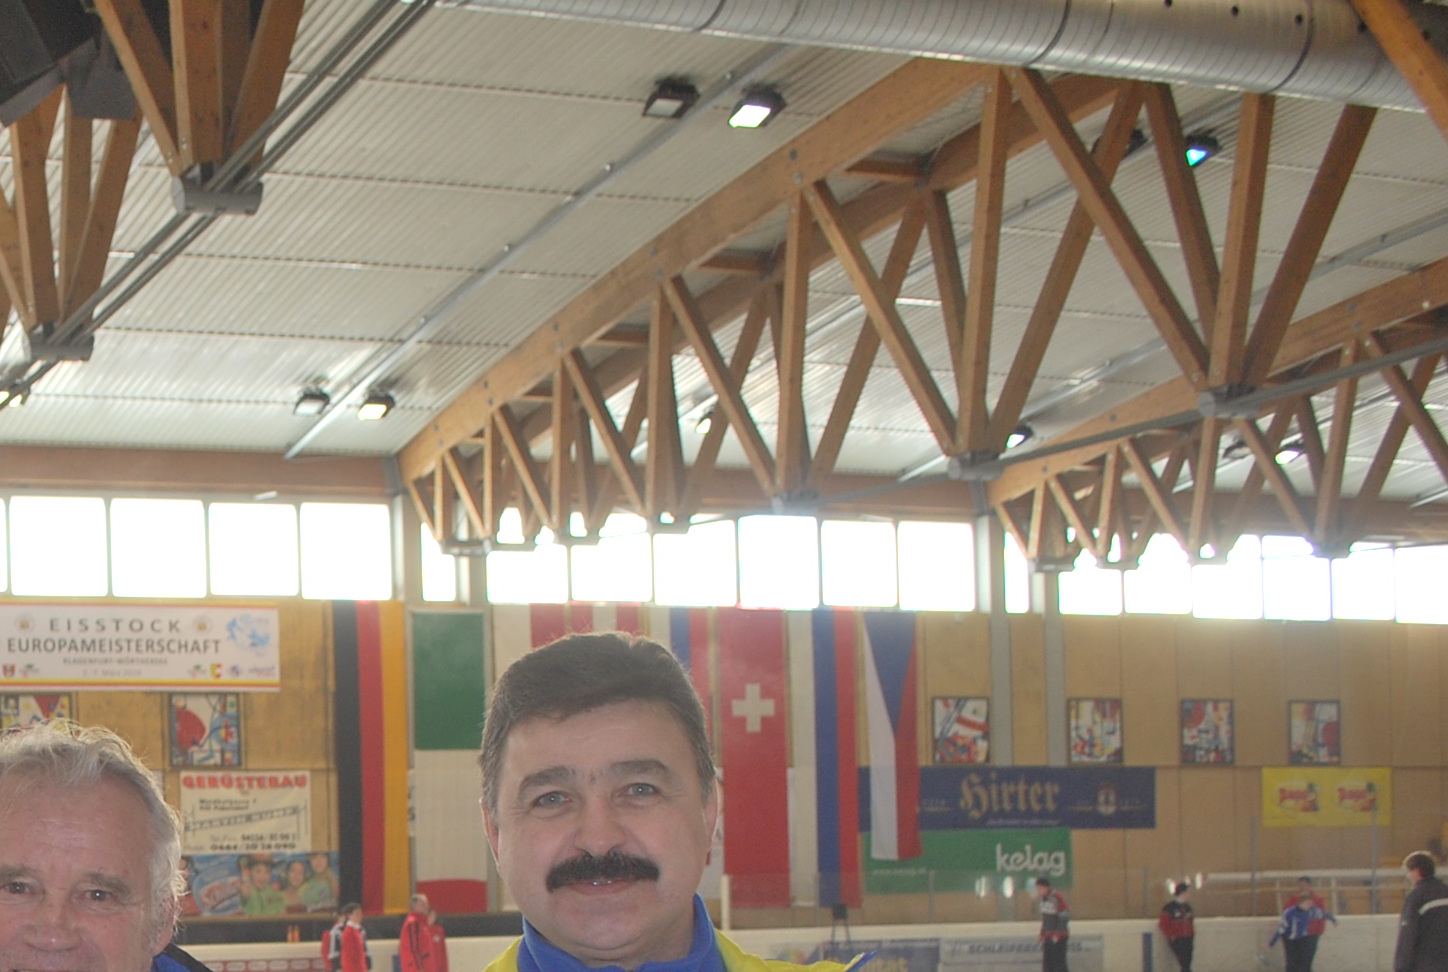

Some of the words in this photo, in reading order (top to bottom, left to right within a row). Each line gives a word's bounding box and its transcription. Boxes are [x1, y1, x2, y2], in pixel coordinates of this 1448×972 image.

[49, 617, 183, 633] EISSTOCK
[7, 637, 221, 655] EUROPAMEISTERSCHAFT
[182, 772, 308, 790] GERÜSTEBAU
[959, 772, 1060, 821] Hirter
[996, 843, 1066, 876] kelag
